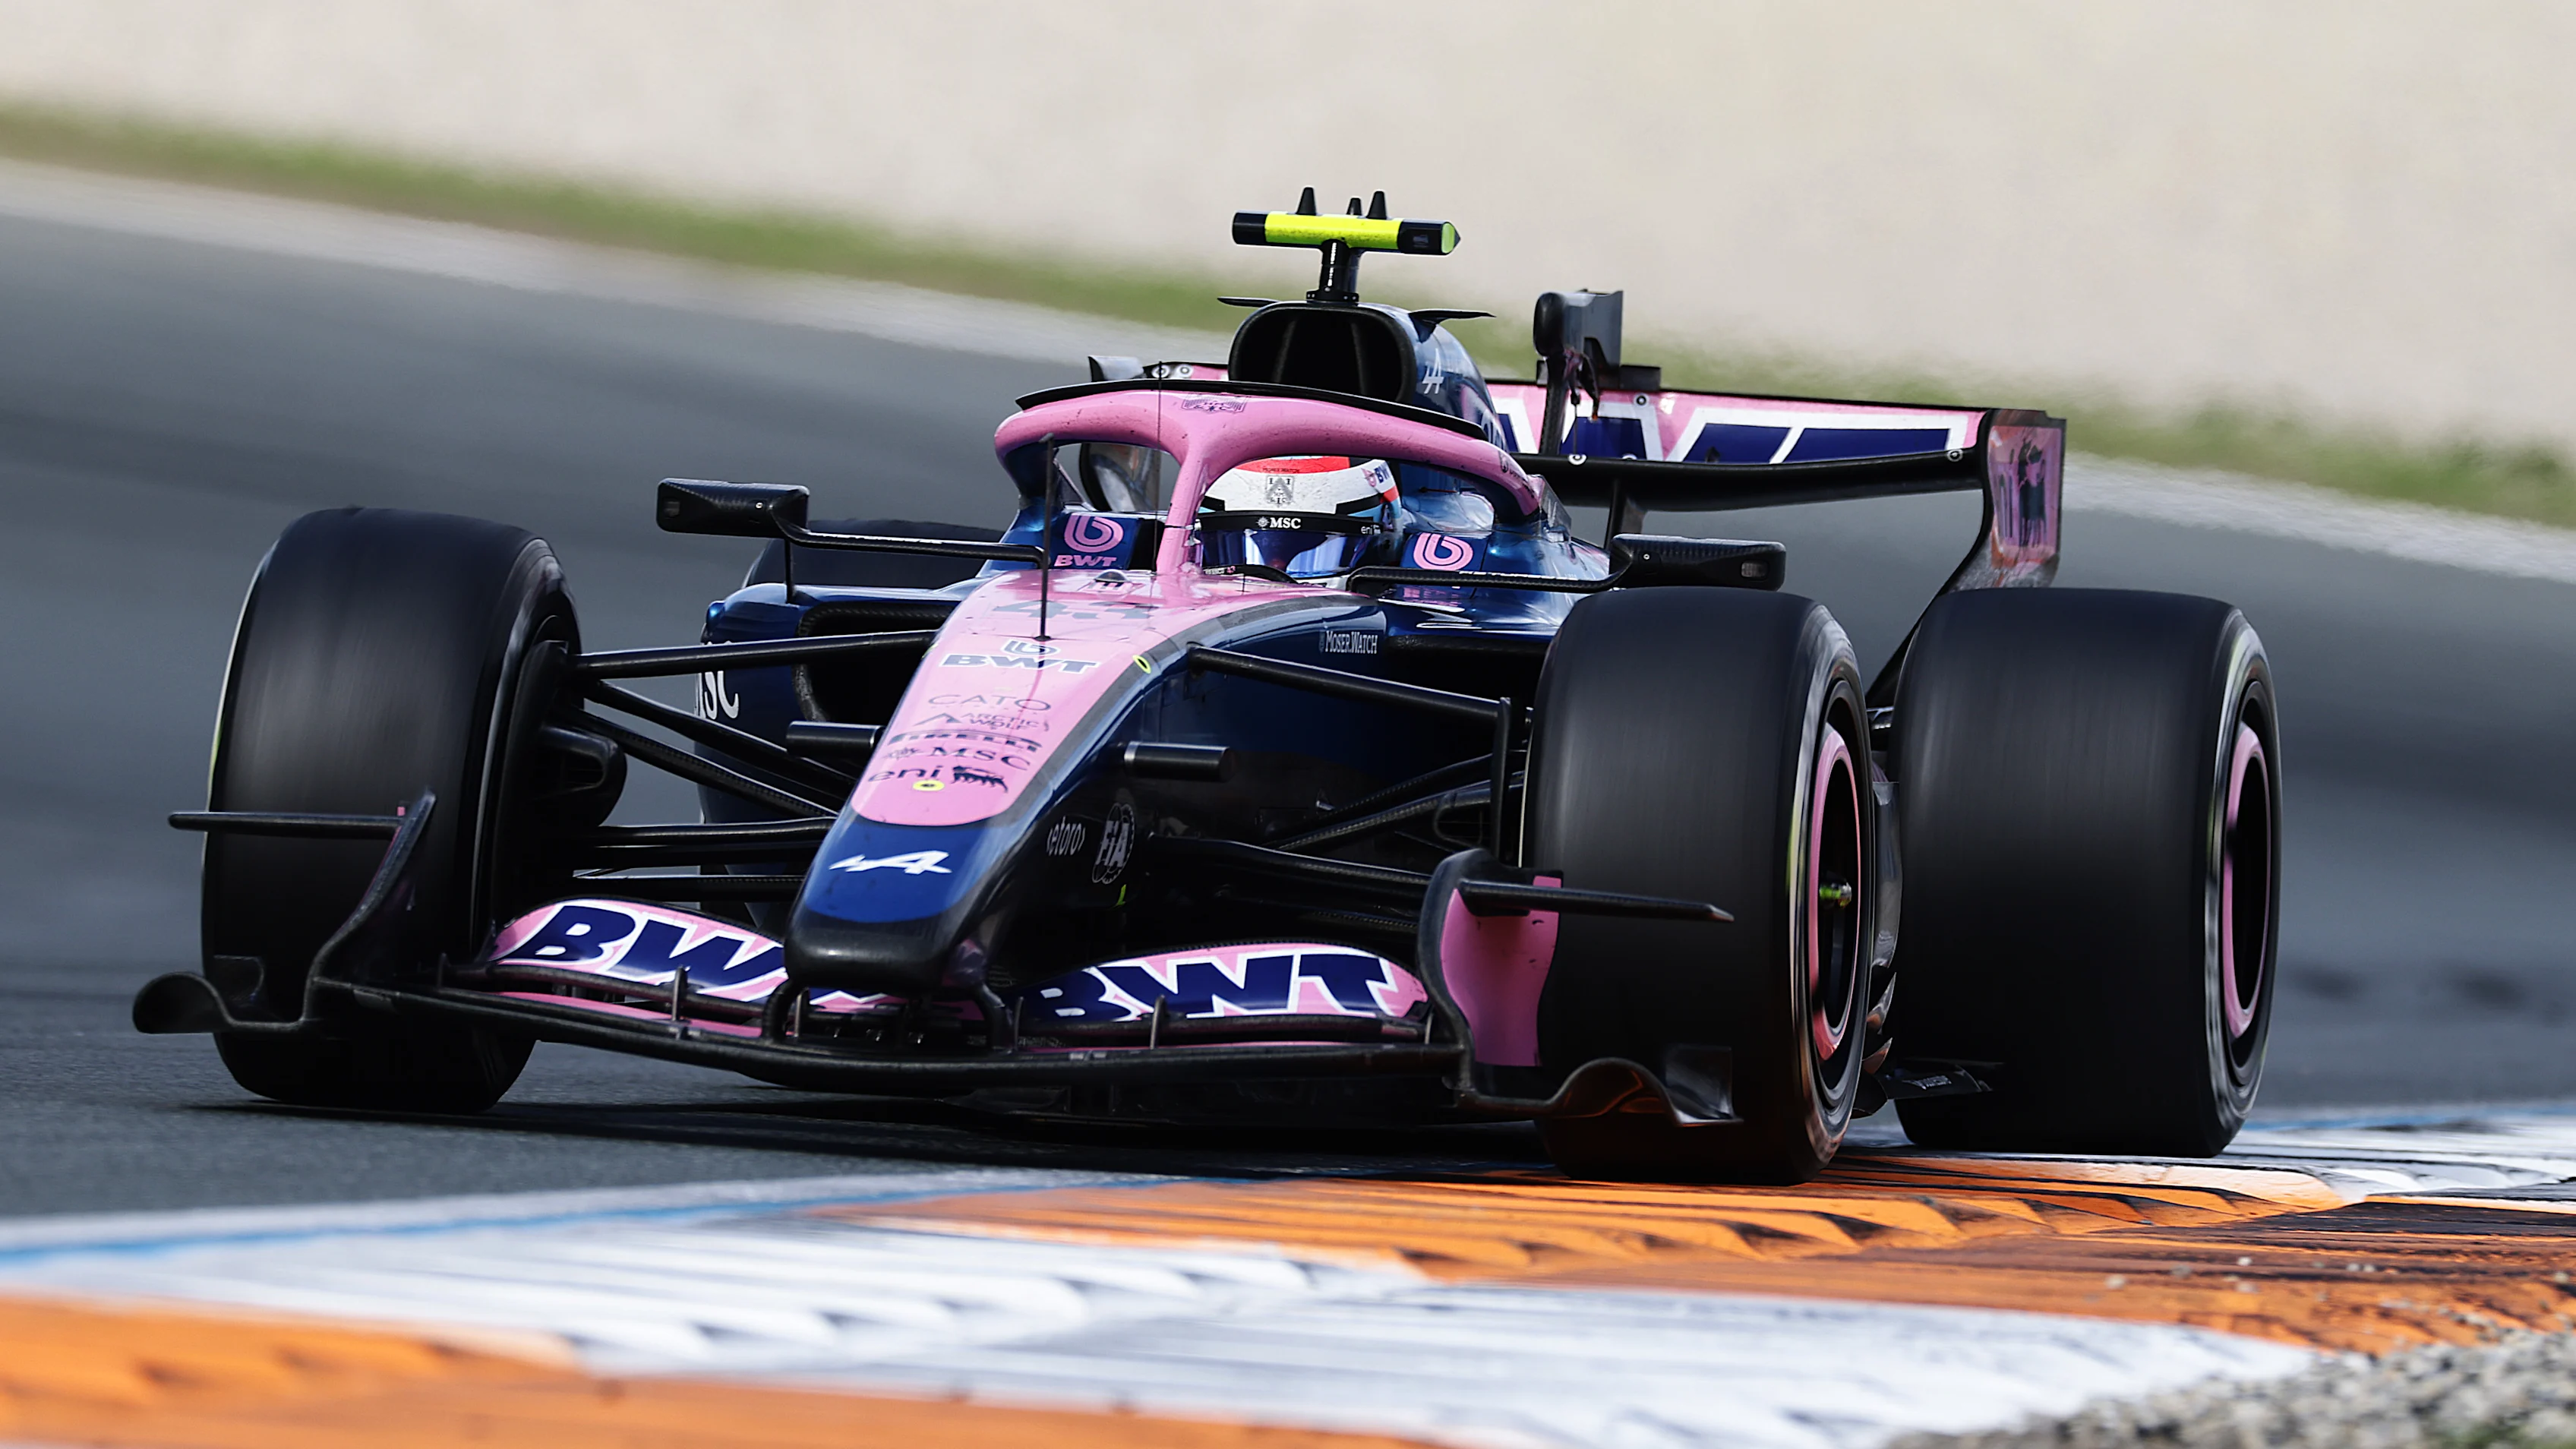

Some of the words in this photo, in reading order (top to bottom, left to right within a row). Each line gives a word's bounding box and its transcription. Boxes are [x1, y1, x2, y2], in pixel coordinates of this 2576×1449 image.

[1270, 517, 1301, 529] MSC
[1361, 526, 1373, 535] eni
[1053, 555, 1117, 567] BWT
[940, 654, 1101, 674] BWT
[928, 694, 1051, 711] CATO
[928, 747, 1031, 770] MSC
[868, 766, 943, 781] eni
[1095, 820, 1130, 867] FIA
[1019, 951, 1399, 1021] BWT
